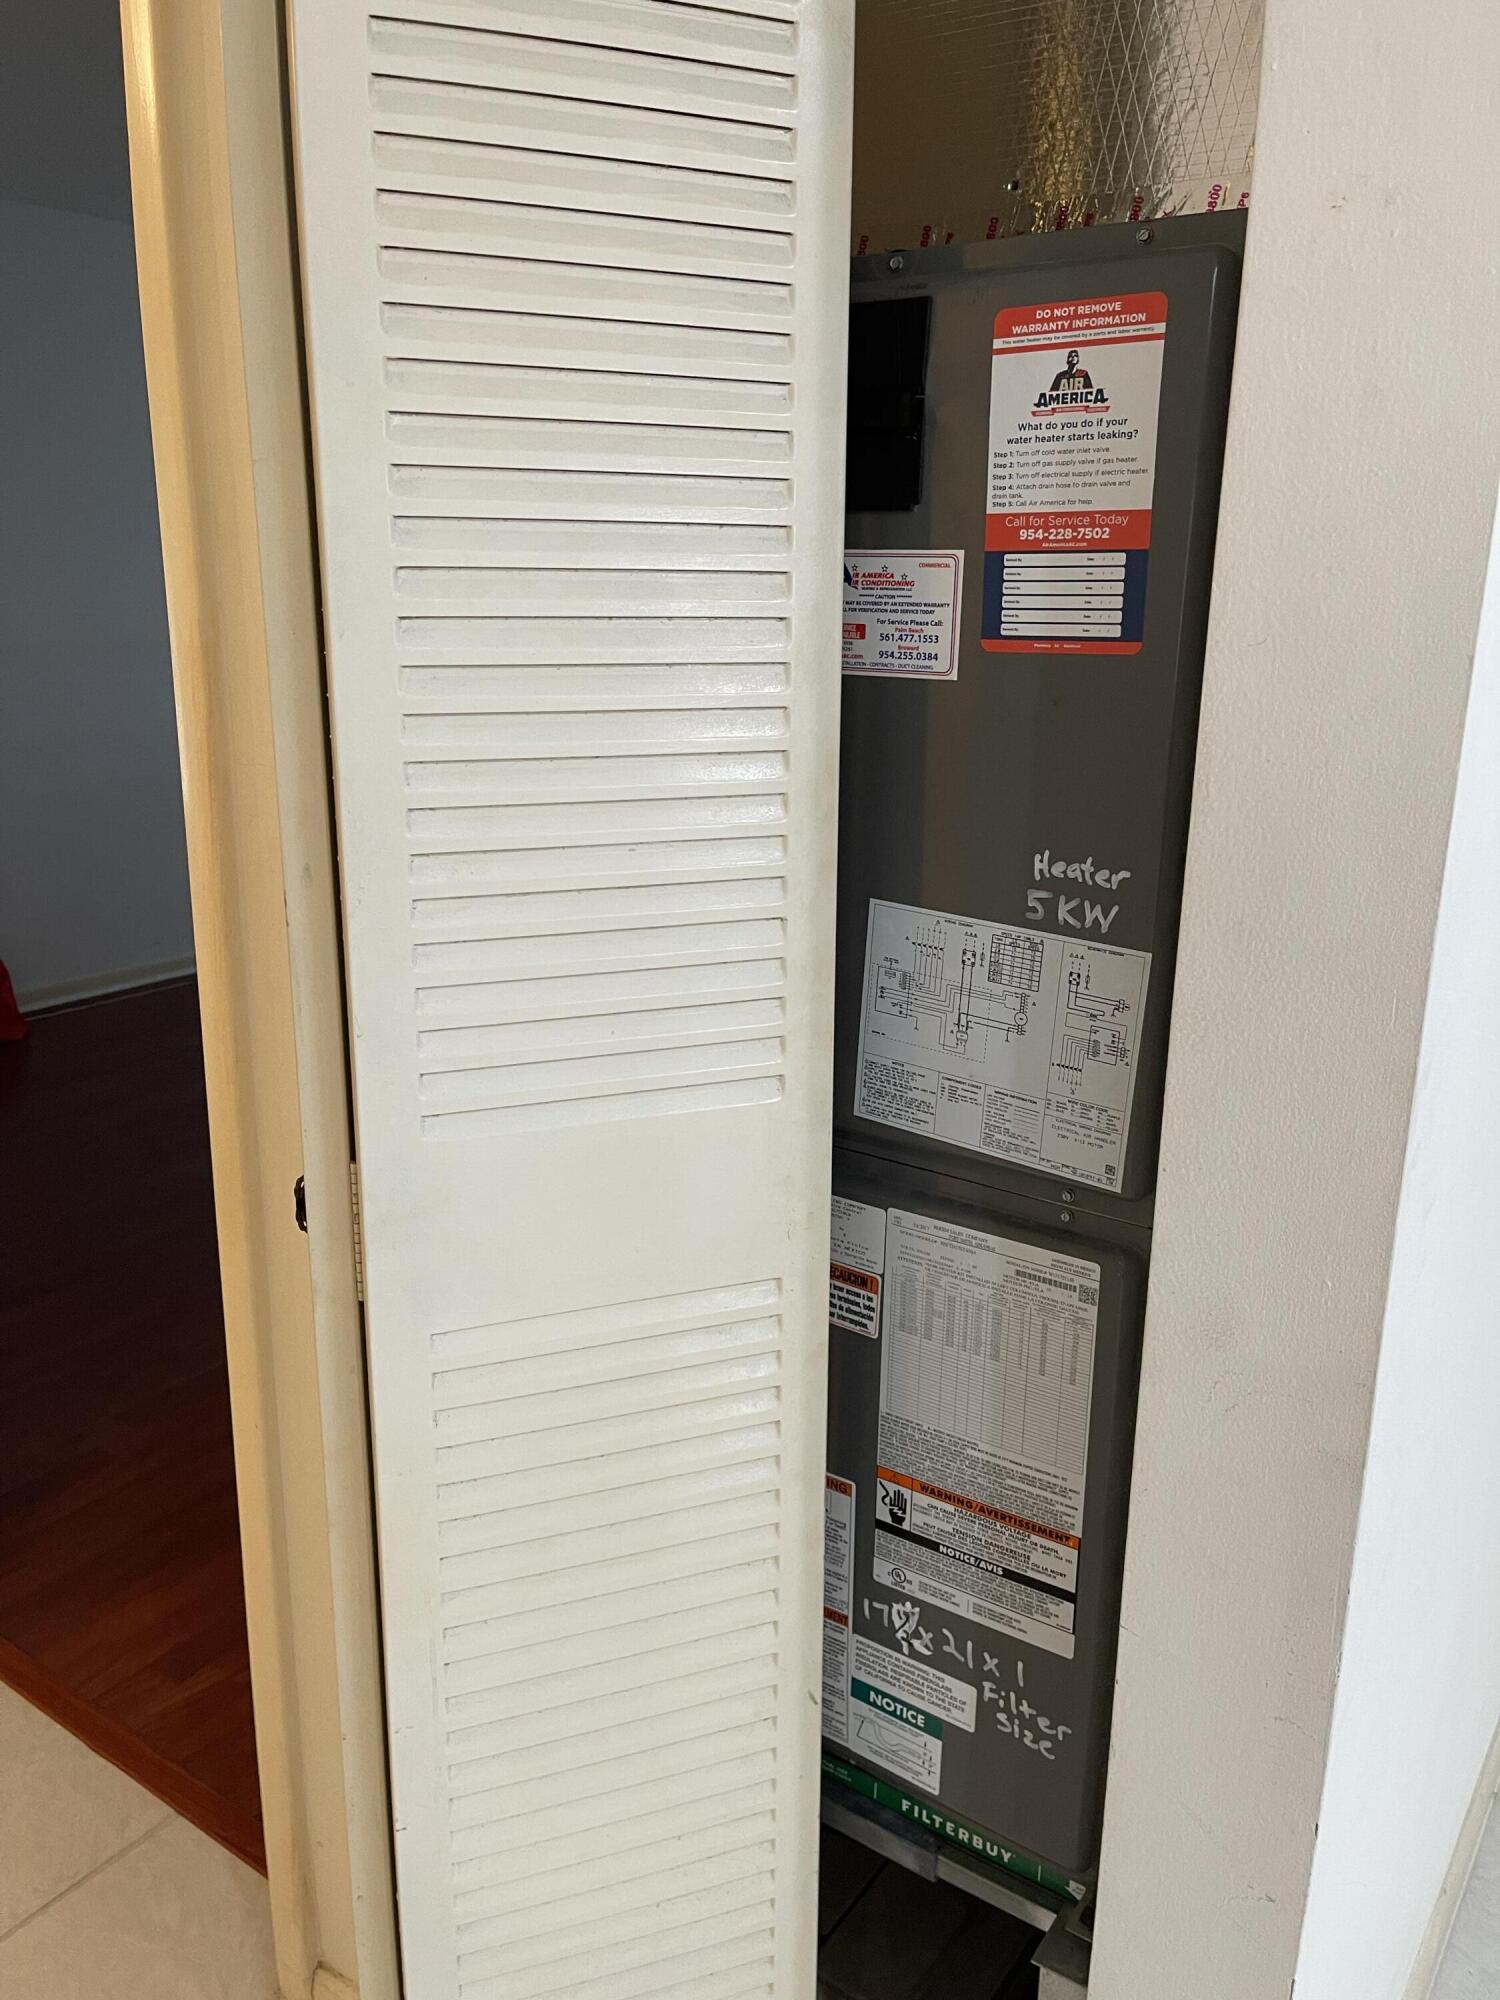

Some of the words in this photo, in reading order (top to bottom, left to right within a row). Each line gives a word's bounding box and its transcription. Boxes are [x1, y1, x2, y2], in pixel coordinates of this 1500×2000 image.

[1036, 309, 1052, 319] DO
[1054, 307, 1075, 317] NOT
[1078, 302, 1122, 314] REMOVE
[1012, 320, 1070, 334] WARRANTY
[1073, 313, 1146, 328] INFORMATION
[1059, 378, 1083, 391] AIR
[1034, 388, 1108, 408] AMERICA
[1018, 422, 1042, 431] What
[1046, 421, 1057, 430] do
[1061, 420, 1078, 430] you
[1081, 419, 1093, 428] do
[1097, 419, 1103, 427] if
[1106, 418, 1128, 427] your
[1007, 436, 1032, 445] water
[1035, 434, 1065, 443] heater
[1068, 432, 1094, 442] starts
[1098, 430, 1138, 440] leaking?
[1006, 516, 1026, 527] Call
[1029, 516, 1044, 526] for
[1048, 515, 1090, 526] Service
[1094, 514, 1129, 526] Today
[1020, 528, 1110, 540] 954-228-7502
[880, 633, 939, 643] 561.477.1553
[879, 651, 938, 660] 954.255.0384
[1034, 849, 1131, 889] Heater
[953, 1508, 998, 1529] HAZARDOUS
[999, 1524, 1031, 1539] VOLTAGE
[952, 1527, 983, 1544] TENSION
[984, 1539, 1031, 1561] DANGEREUSE
[939, 1544, 1003, 1575] NOTICE/AVIS
[870, 1690, 925, 1728] NOTICE
[982, 1681, 1072, 1741] Filter
[996, 1712, 1055, 1759] Size
[901, 1799, 1012, 1863] FILTERBUY
